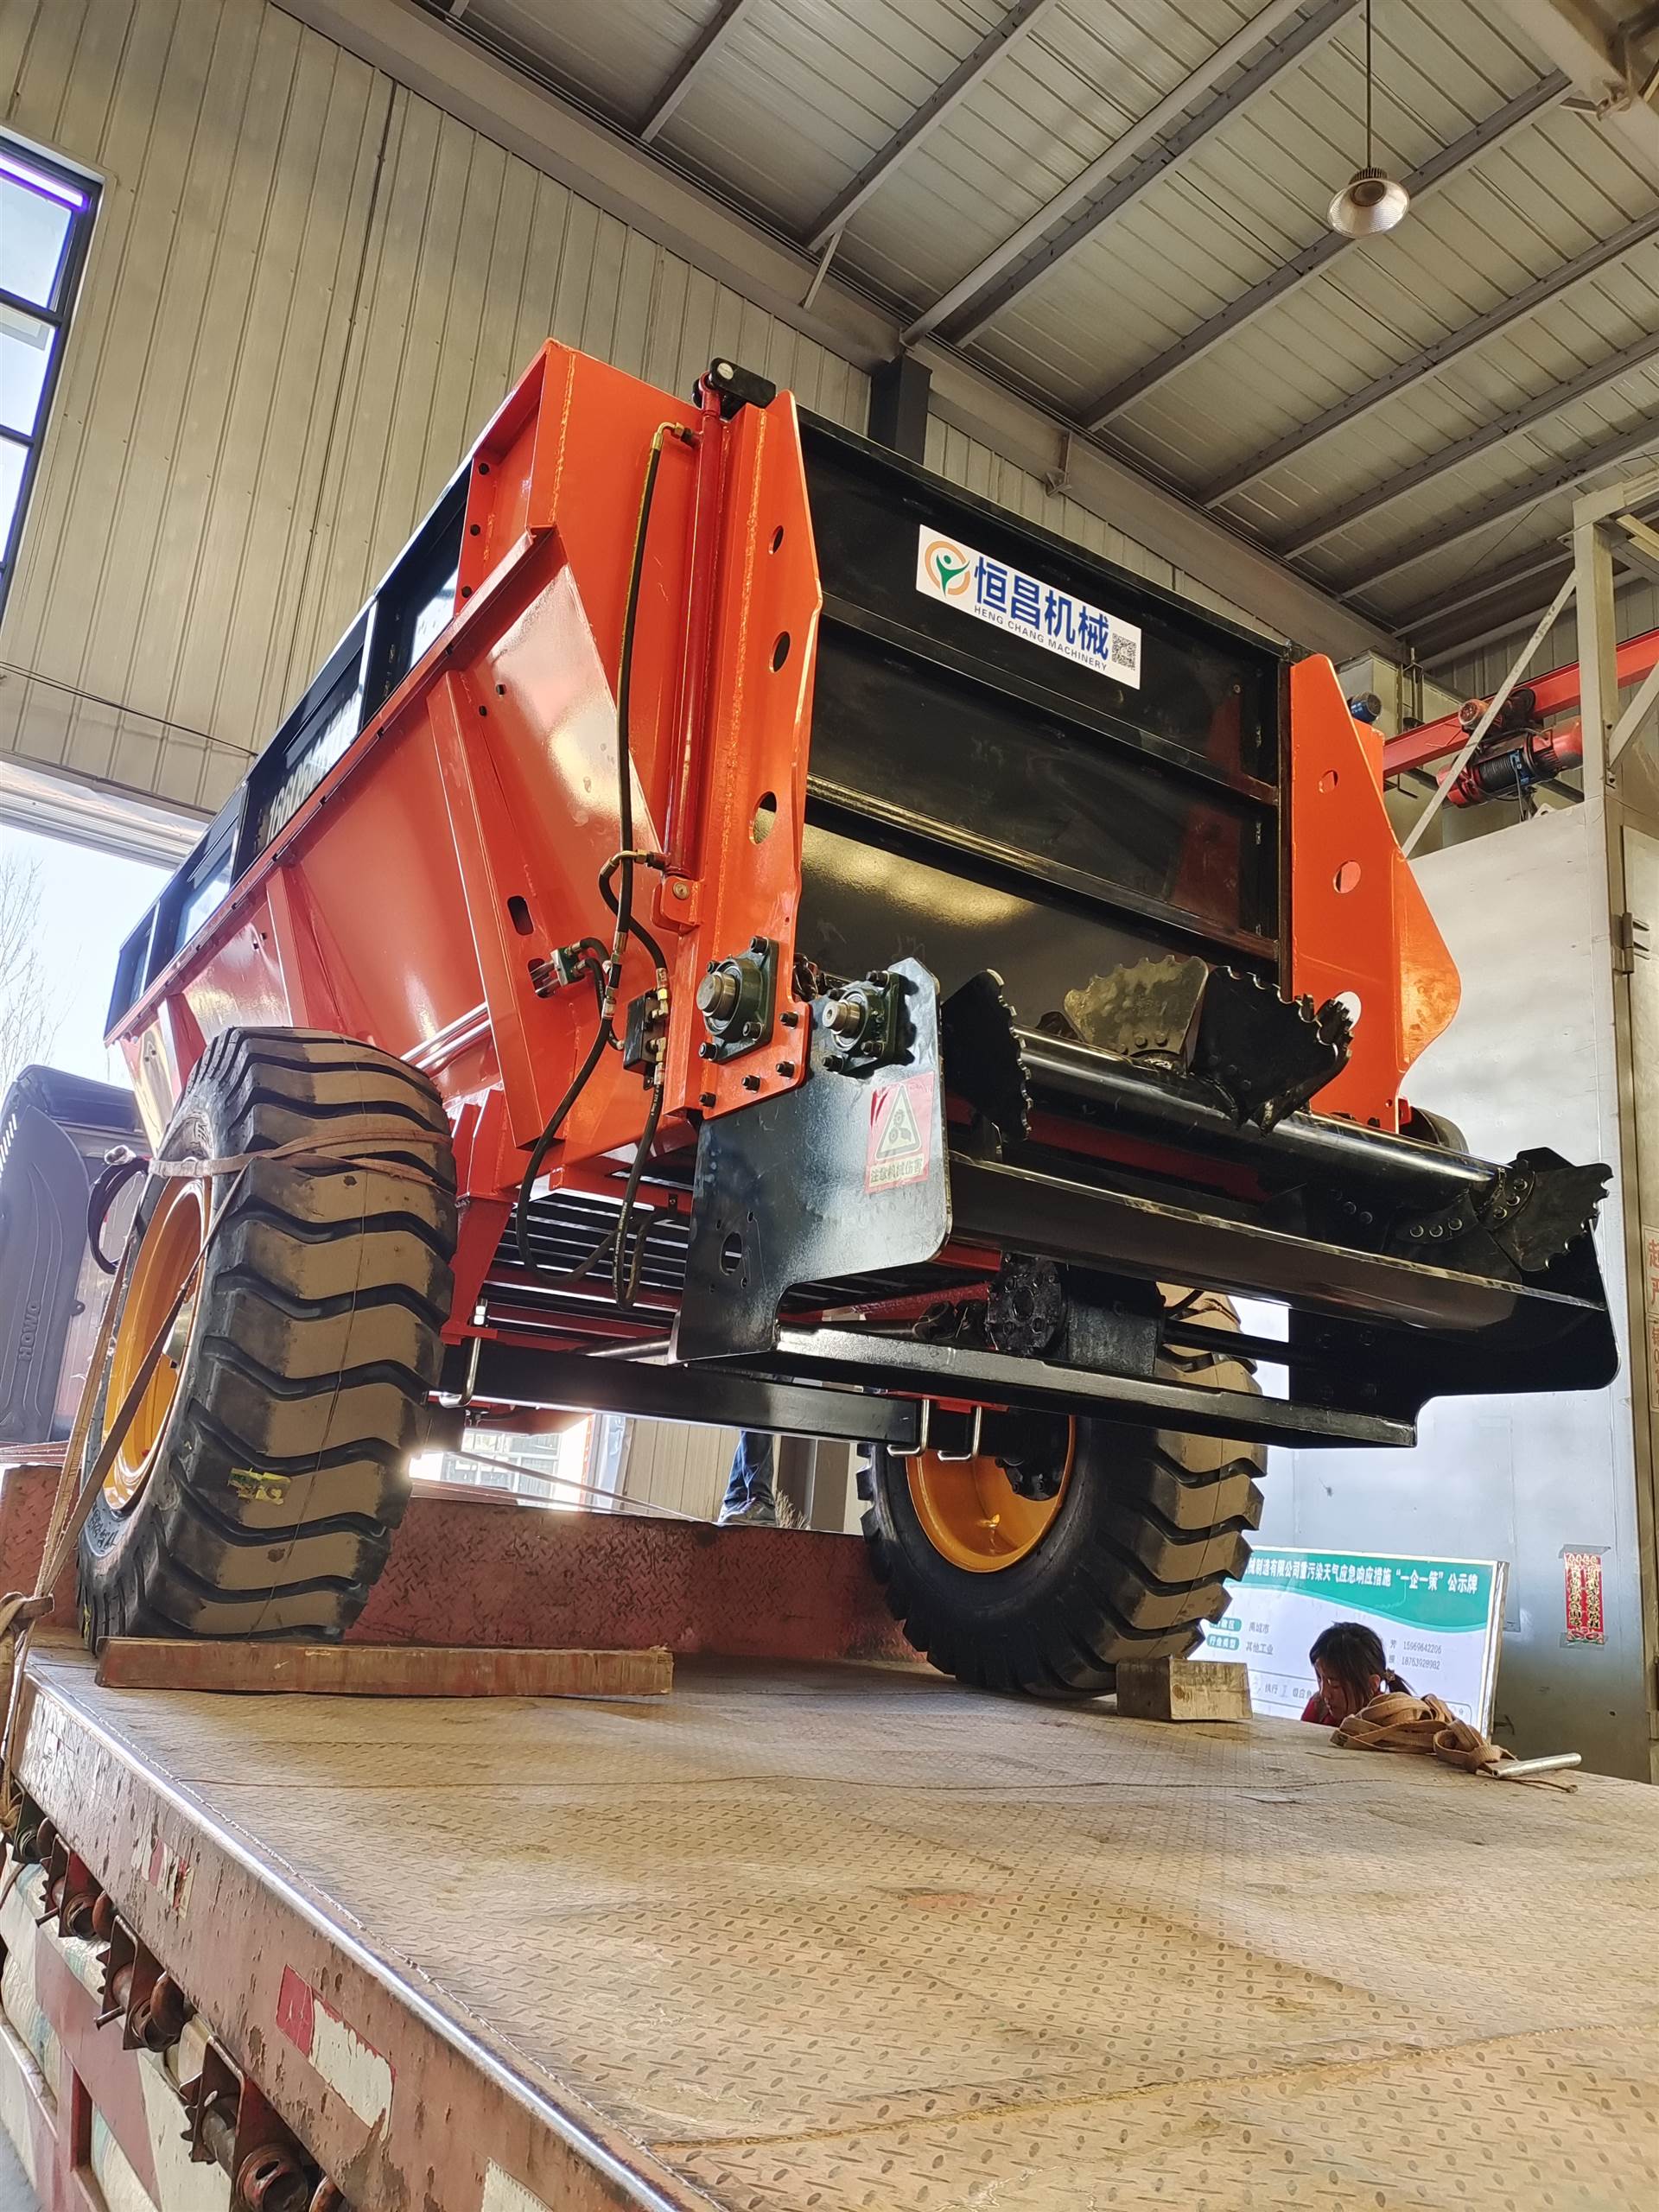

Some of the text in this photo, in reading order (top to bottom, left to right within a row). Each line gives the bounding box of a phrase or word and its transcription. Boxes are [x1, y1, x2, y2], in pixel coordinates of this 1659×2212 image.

[974, 556, 1109, 661] 恒昌机械
[974, 605, 1108, 671] HENG CHANG MACHINERY
[19, 1300, 40, 1361] HOWO
